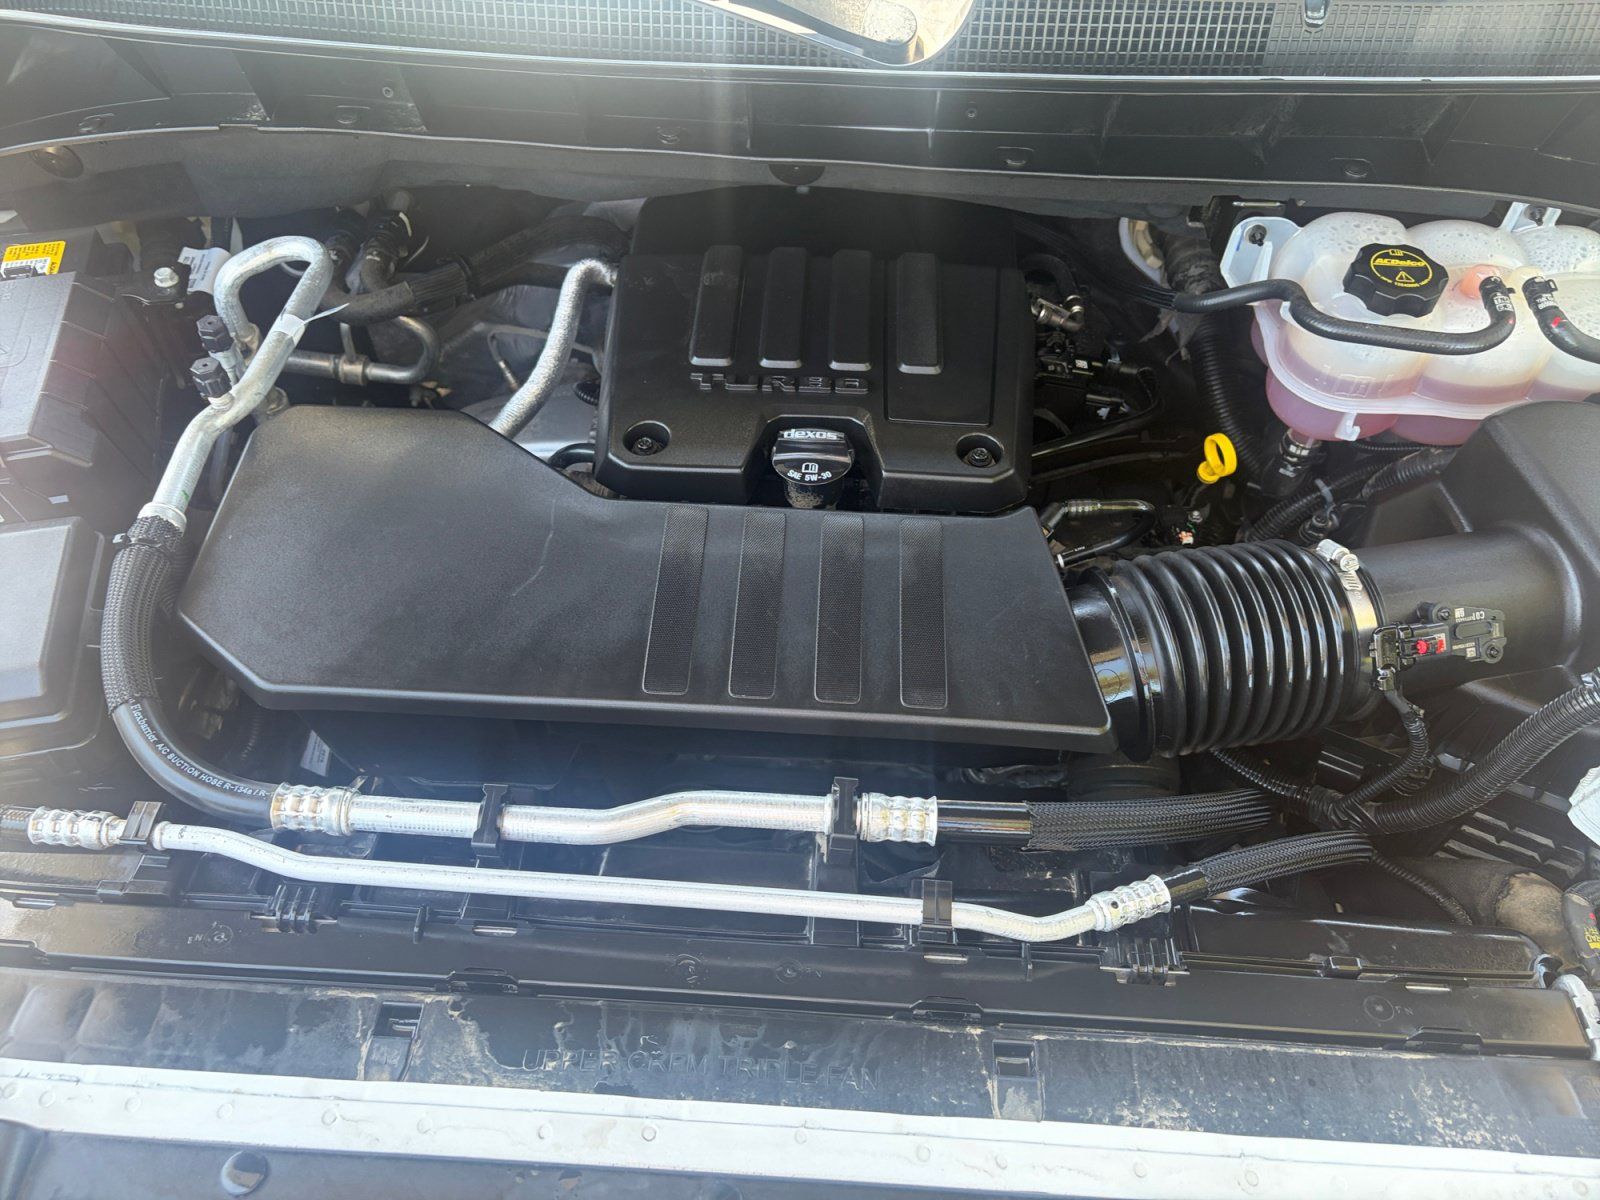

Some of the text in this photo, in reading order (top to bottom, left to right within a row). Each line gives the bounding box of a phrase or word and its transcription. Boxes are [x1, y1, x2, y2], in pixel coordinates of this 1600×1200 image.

[1374, 258, 1426, 267] ACDelco
[783, 429, 838, 440] dexos
[787, 470, 832, 481] SAE 5W-30
[130, 703, 157, 744] Flexbarrier
[156, 743, 170, 755] A/C
[167, 753, 200, 777] SUCTION
[199, 770, 223, 788] HOSE
[522, 1048, 619, 1072] UPPER
[719, 1055, 818, 1087] TRIPLE
[826, 1063, 881, 1091] FAN
